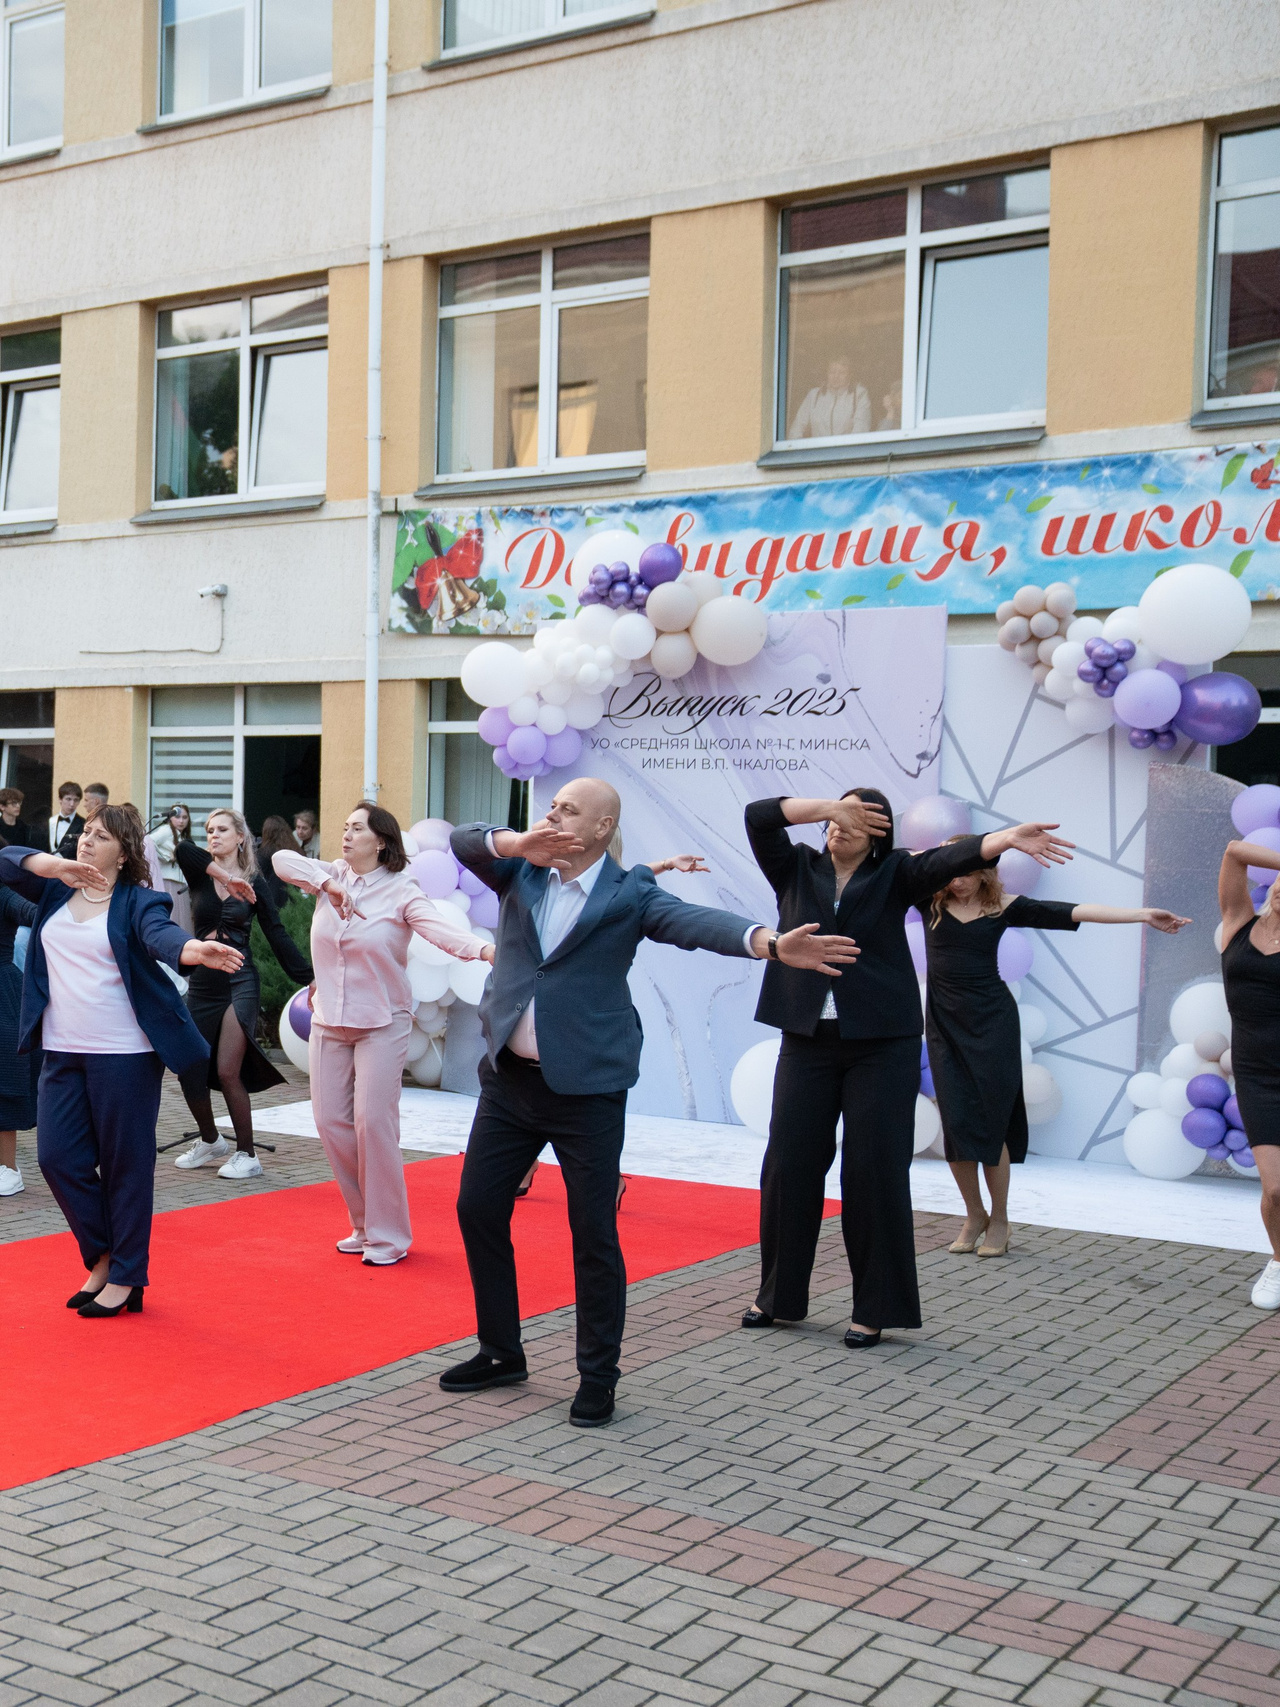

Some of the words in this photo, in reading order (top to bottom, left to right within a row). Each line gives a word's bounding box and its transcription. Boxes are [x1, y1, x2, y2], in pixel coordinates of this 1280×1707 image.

[666, 512, 1007, 603] видания,
[602, 671, 761, 735] Выпуск
[759, 687, 862, 717] 2025
[591, 738, 610, 750] УО
[614, 737, 690, 752] «СРЕДНЯЯ
[694, 738, 752, 750] ШКОЛА
[800, 738, 871, 751] МИНСКА
[642, 758, 696, 770] ИМЕНИ
[701, 758, 729, 770] В.П.
[732, 758, 810, 771] ЧКАЛОВА
